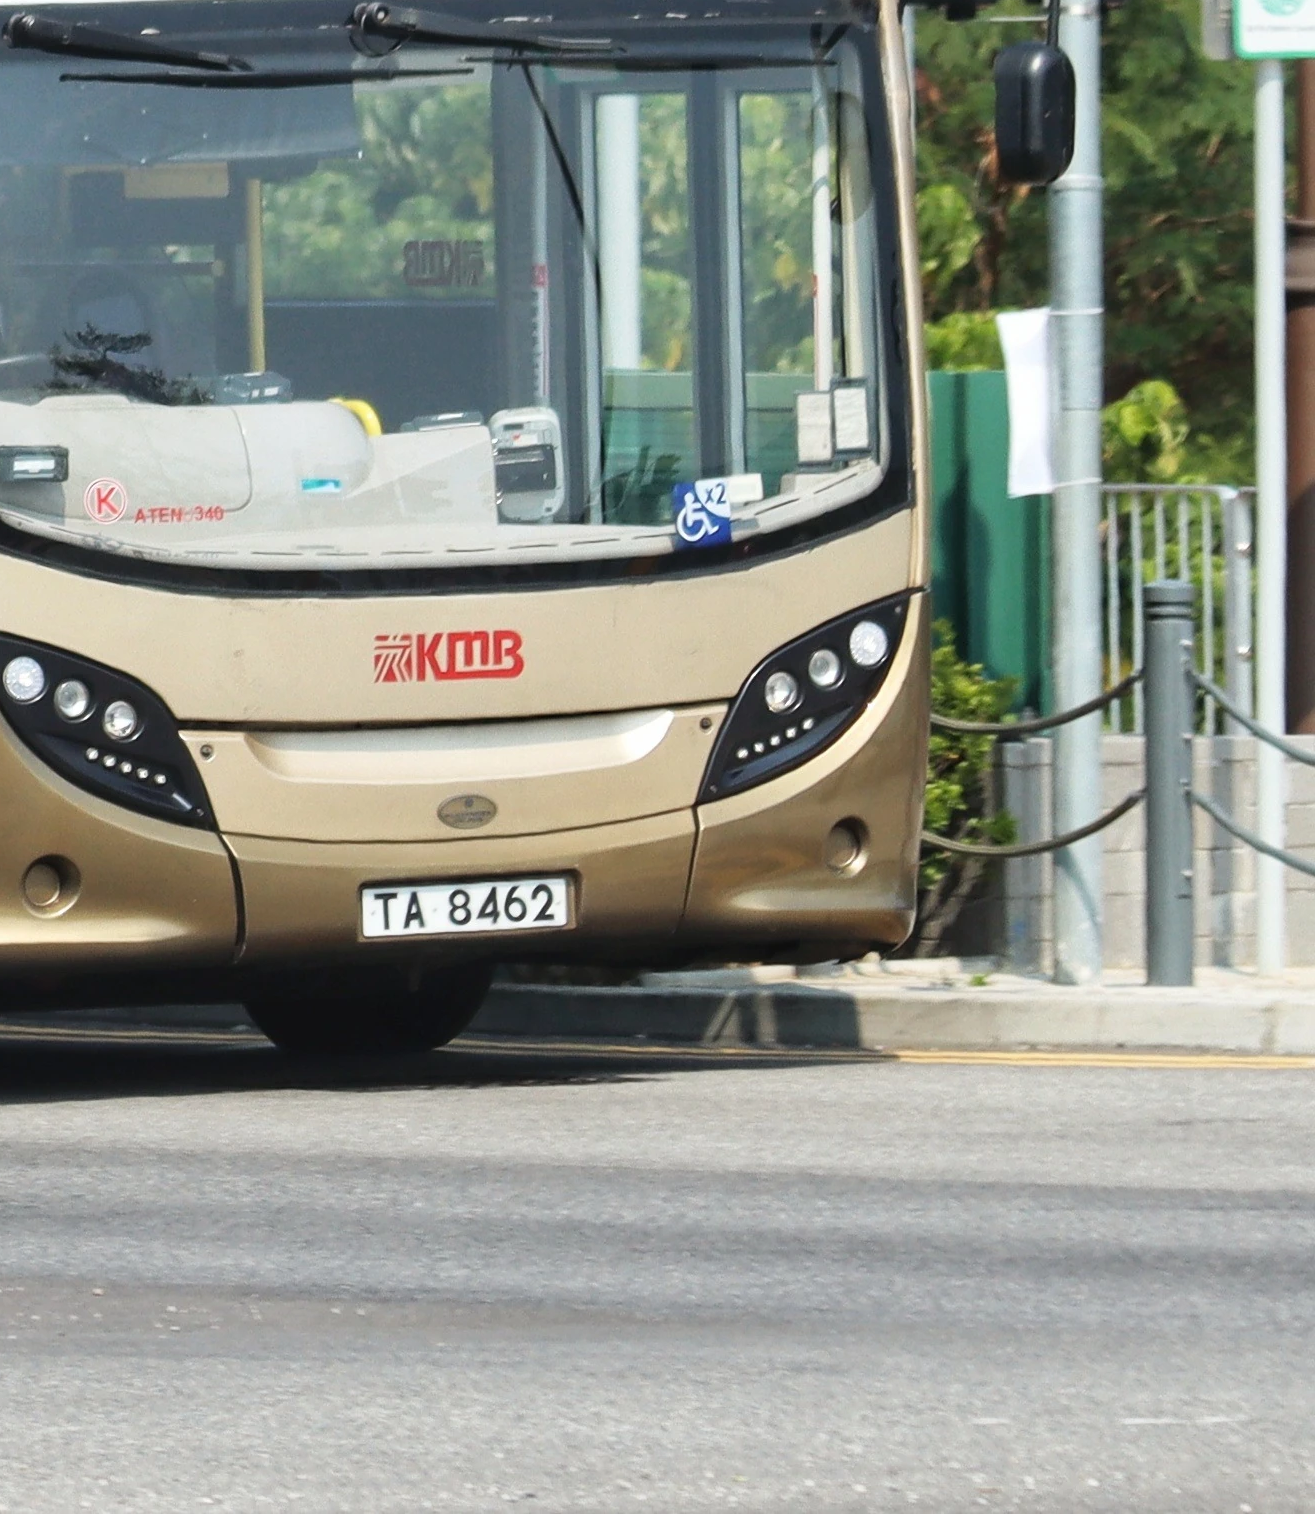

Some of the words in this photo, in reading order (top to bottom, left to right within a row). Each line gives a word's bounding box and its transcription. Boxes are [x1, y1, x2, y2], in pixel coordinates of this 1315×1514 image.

[416, 629, 525, 682] KMB
[373, 891, 426, 931] TA
[448, 883, 555, 926] 8462
